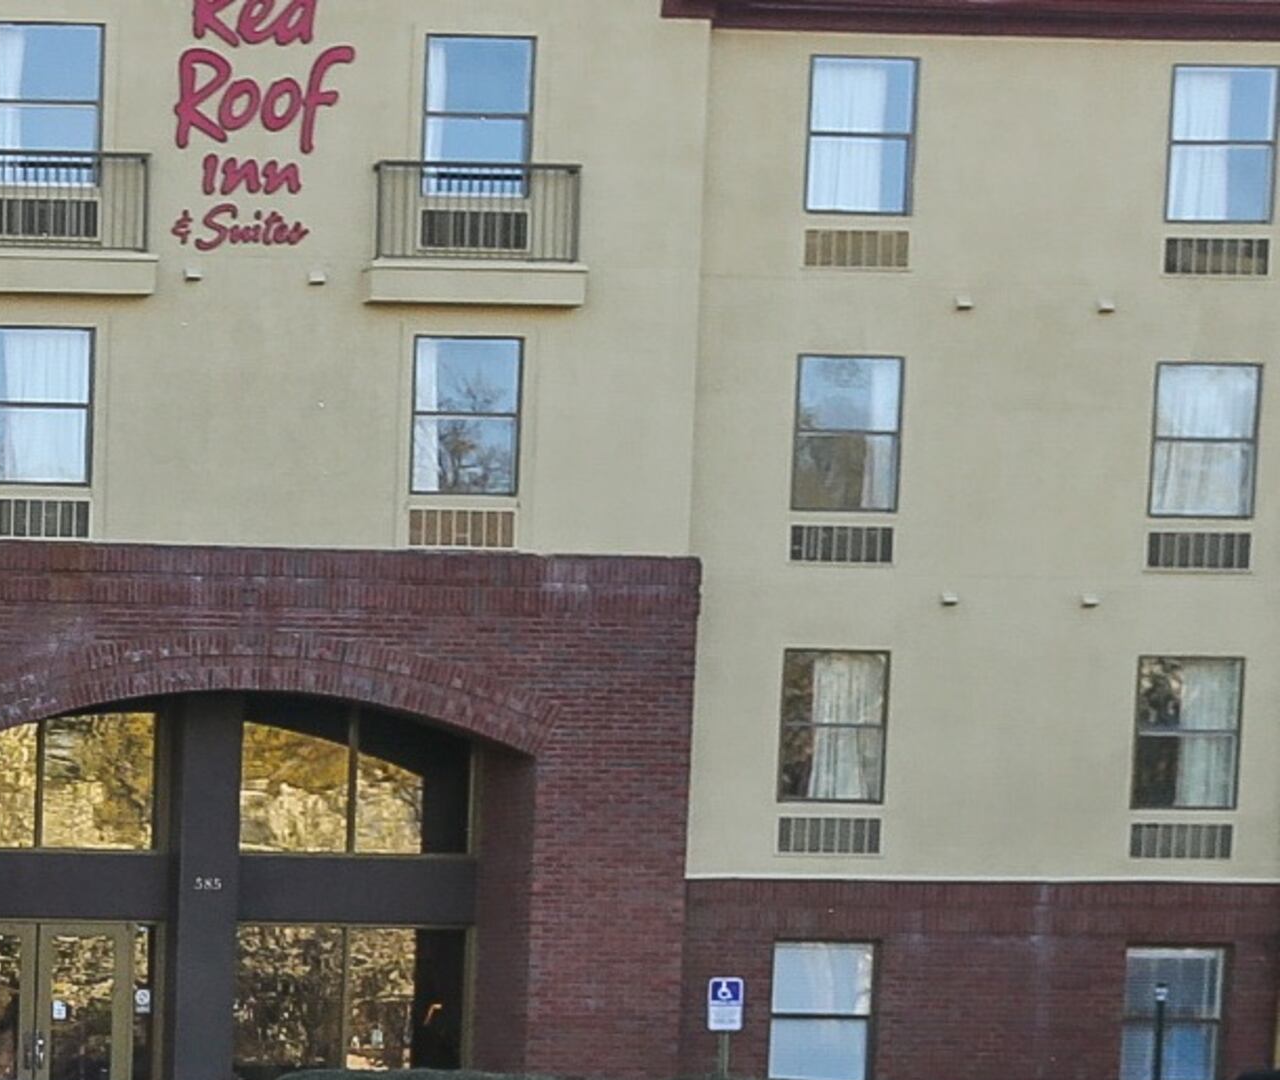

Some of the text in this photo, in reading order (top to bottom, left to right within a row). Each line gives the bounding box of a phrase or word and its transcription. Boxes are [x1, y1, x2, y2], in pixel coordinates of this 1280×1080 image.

[173, 45, 356, 154] Roof
[202, 153, 302, 196] Inn
[170, 203, 310, 251] & Suites
[194, 877, 222, 890] 585
